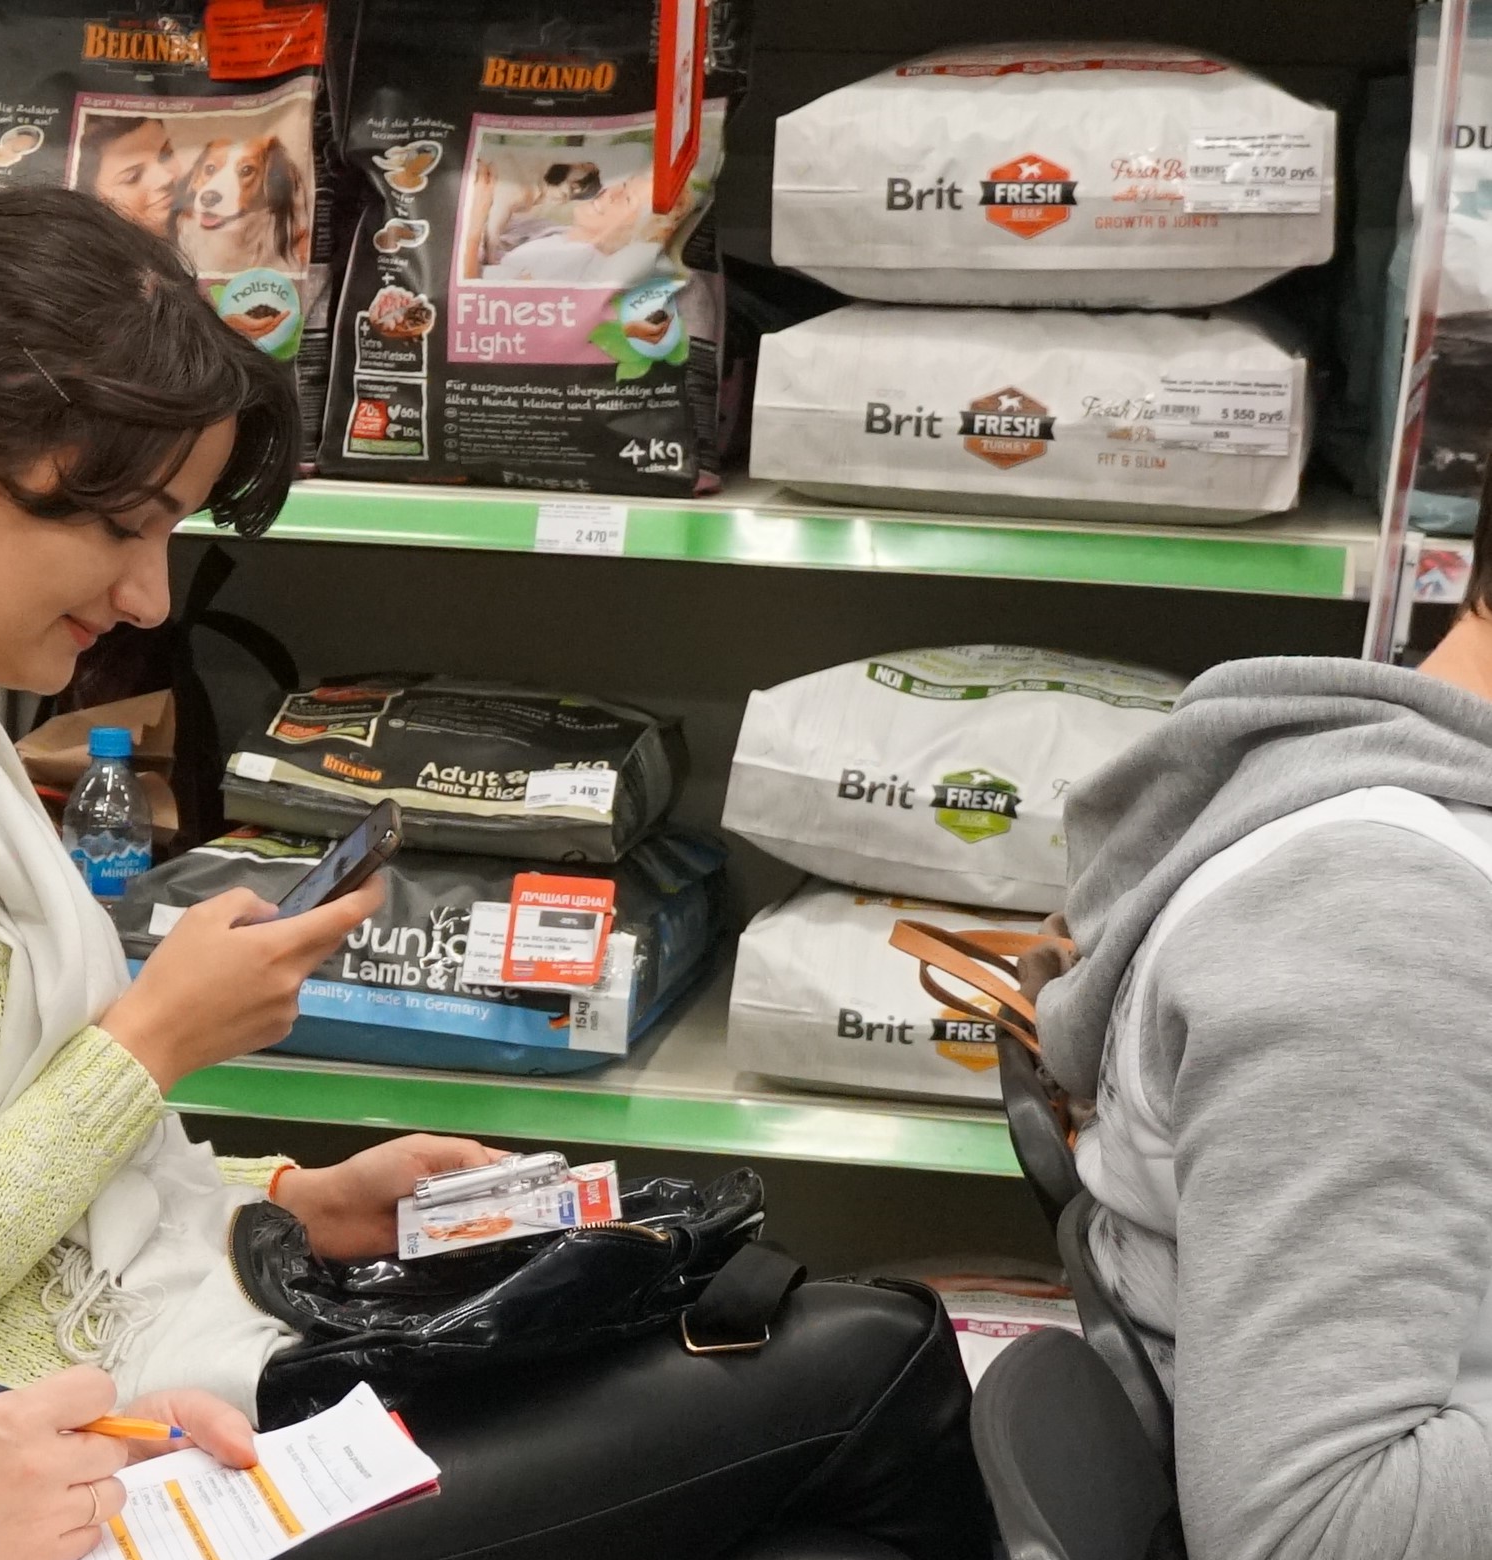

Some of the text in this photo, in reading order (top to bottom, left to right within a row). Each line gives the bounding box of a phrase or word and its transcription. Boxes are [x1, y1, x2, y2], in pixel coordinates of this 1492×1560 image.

[482, 56, 616, 92] BELCANDO
[1264, 167, 1285, 178] 750
[886, 177, 963, 211] Brit
[994, 183, 1062, 204] FRESH
[1095, 216, 1153, 229] GROWTH
[456, 293, 577, 327] Finest
[455, 331, 526, 361] Light
[446, 380, 467, 391] Für
[523, 397, 564, 410] kleiner
[567, 400, 592, 411] und
[865, 401, 943, 438] Brit
[973, 414, 1040, 437] FRESH
[619, 439, 646, 465] 4
[980, 438, 1031, 452] TURKEY
[1098, 453, 1115, 465] FIT
[322, 752, 383, 781] BELCANDO
[418, 762, 499, 787] Adult
[416, 775, 466, 797] Lamb
[485, 786, 527, 801] Rice
[837, 769, 915, 810] Brit
[946, 786, 1009, 814] FRESH
[519, 891, 607, 908] ЛУЧШАЯ ЦЕНА!
[342, 953, 421, 986] Lamb
[300, 983, 490, 1020] Quality Made in Germany
[837, 1008, 915, 1045] Brit
[945, 1021, 996, 1042] FRES
